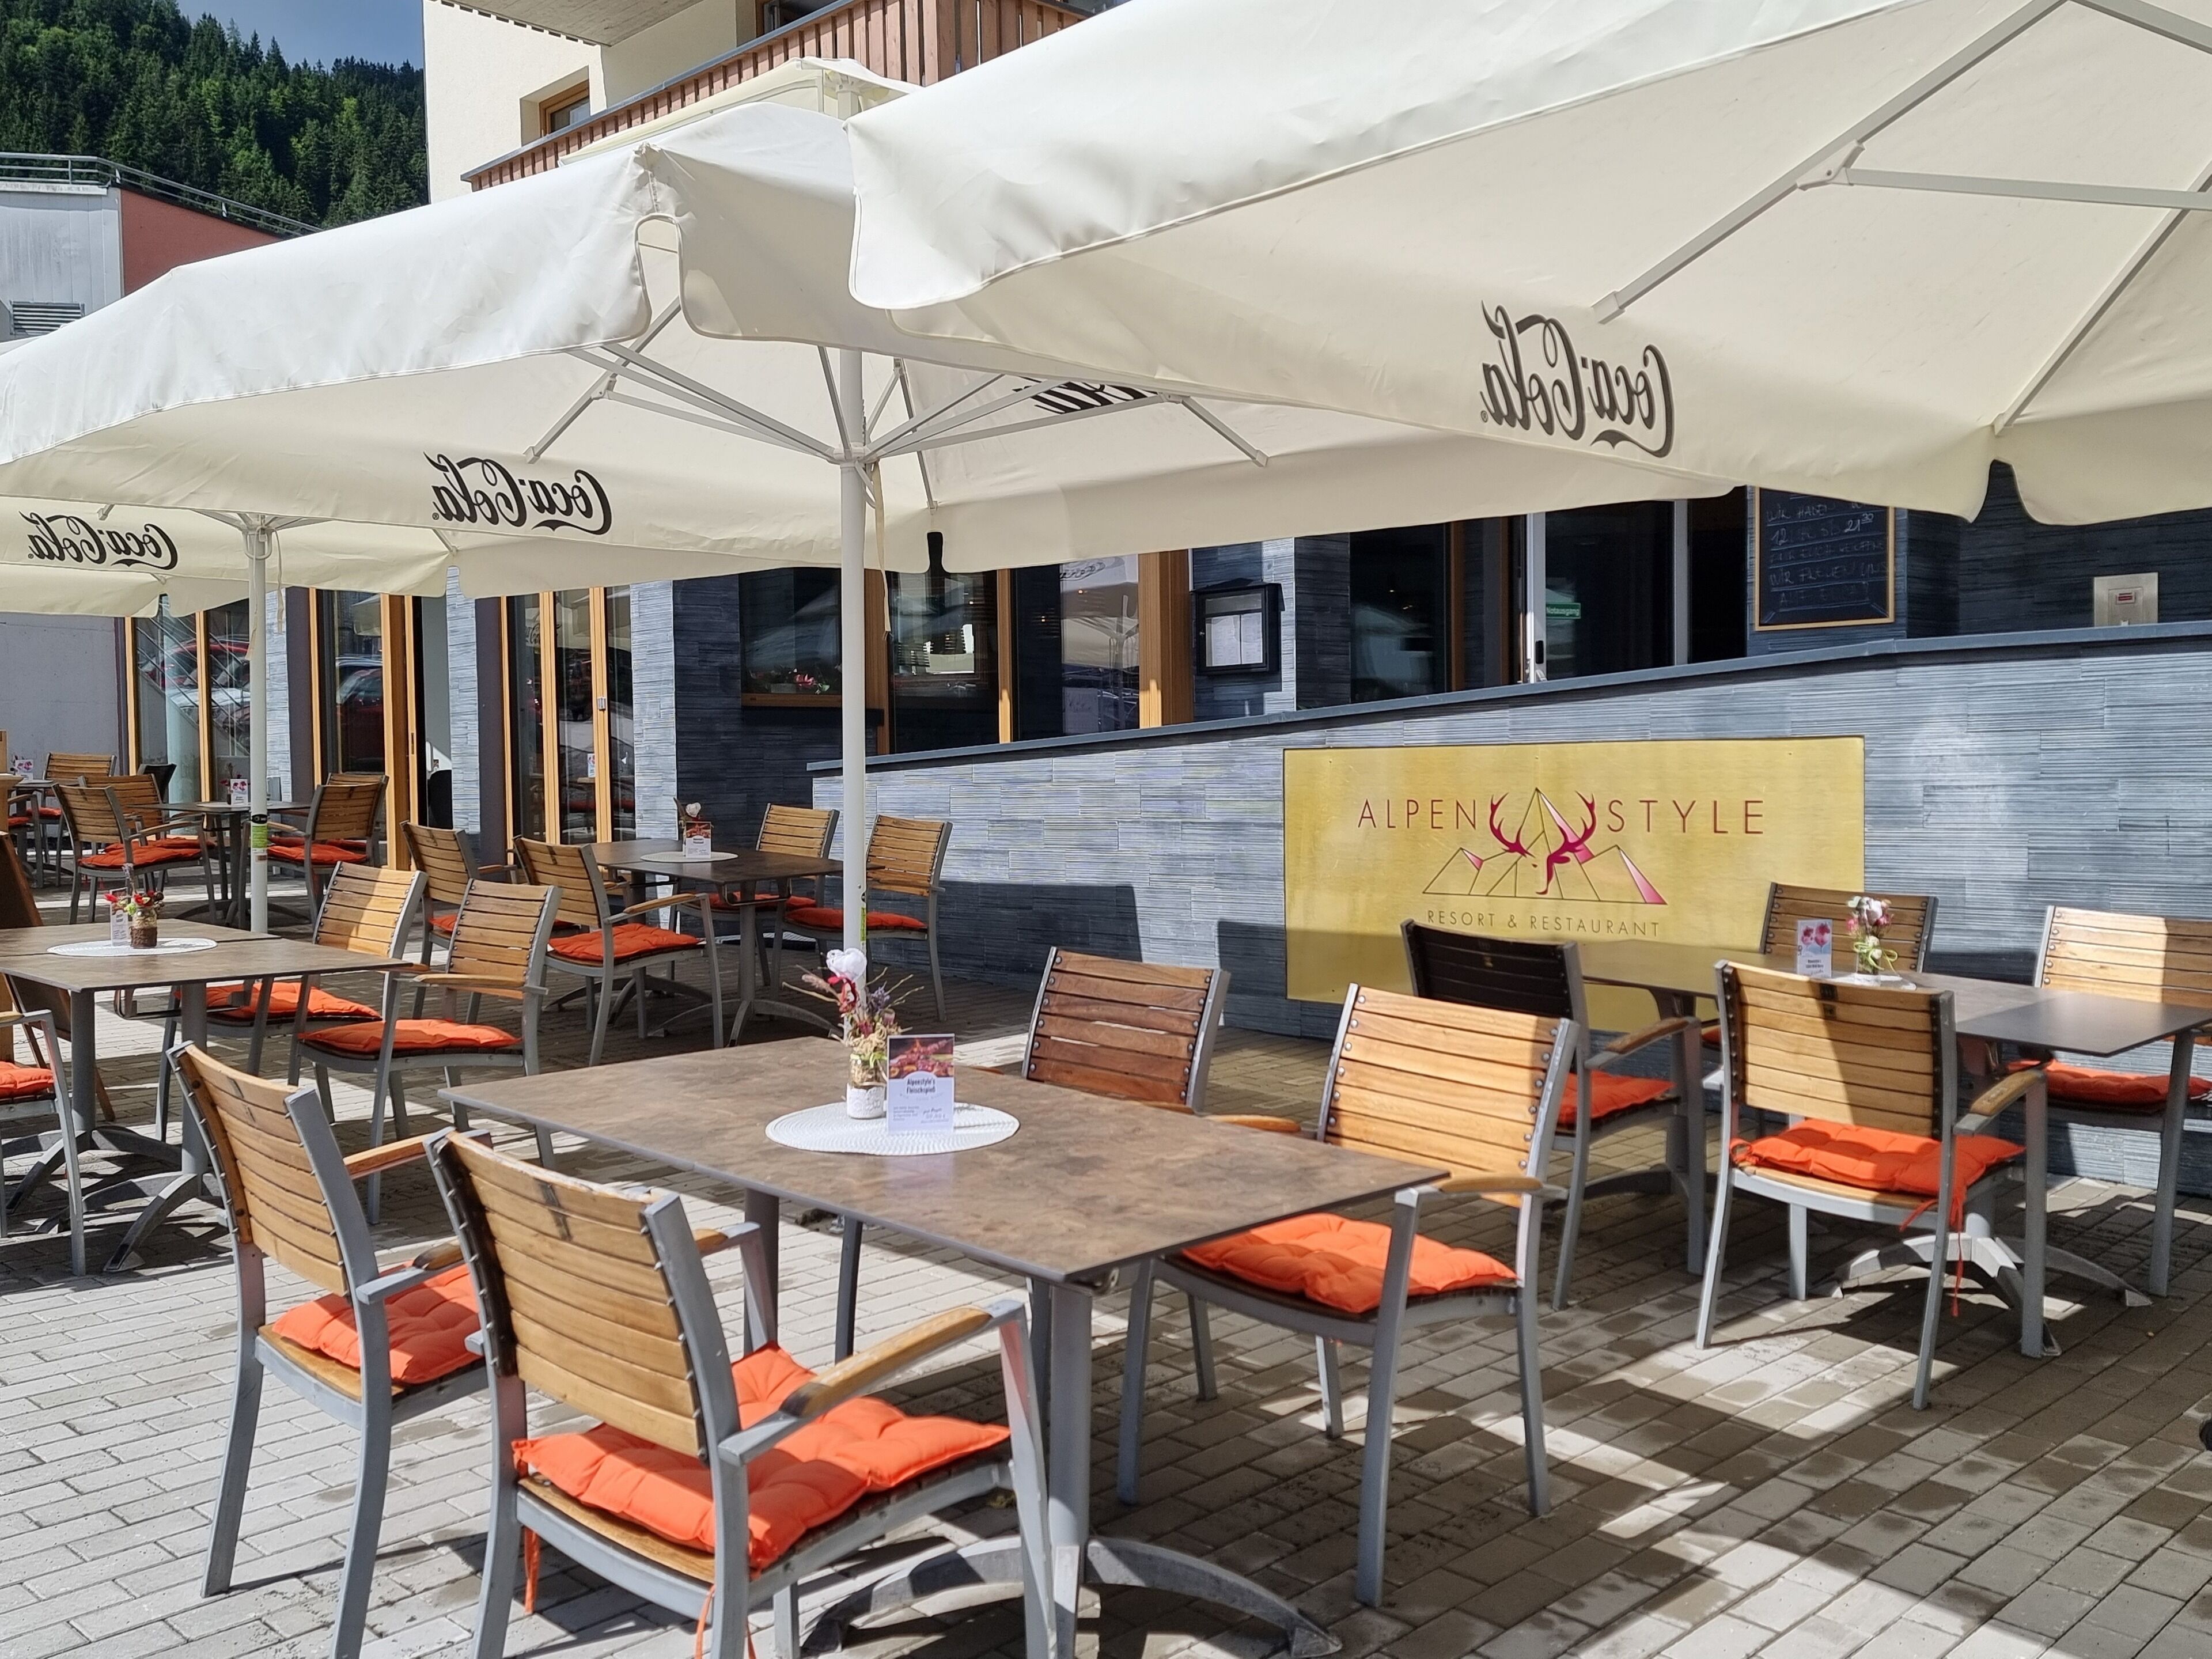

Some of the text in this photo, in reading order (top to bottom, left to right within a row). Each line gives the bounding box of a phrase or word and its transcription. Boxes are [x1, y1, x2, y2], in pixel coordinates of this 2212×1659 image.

[1357, 798, 1764, 834] ALPEN STYLE
[1427, 910, 1659, 937] RESORT & RESTAURANT
